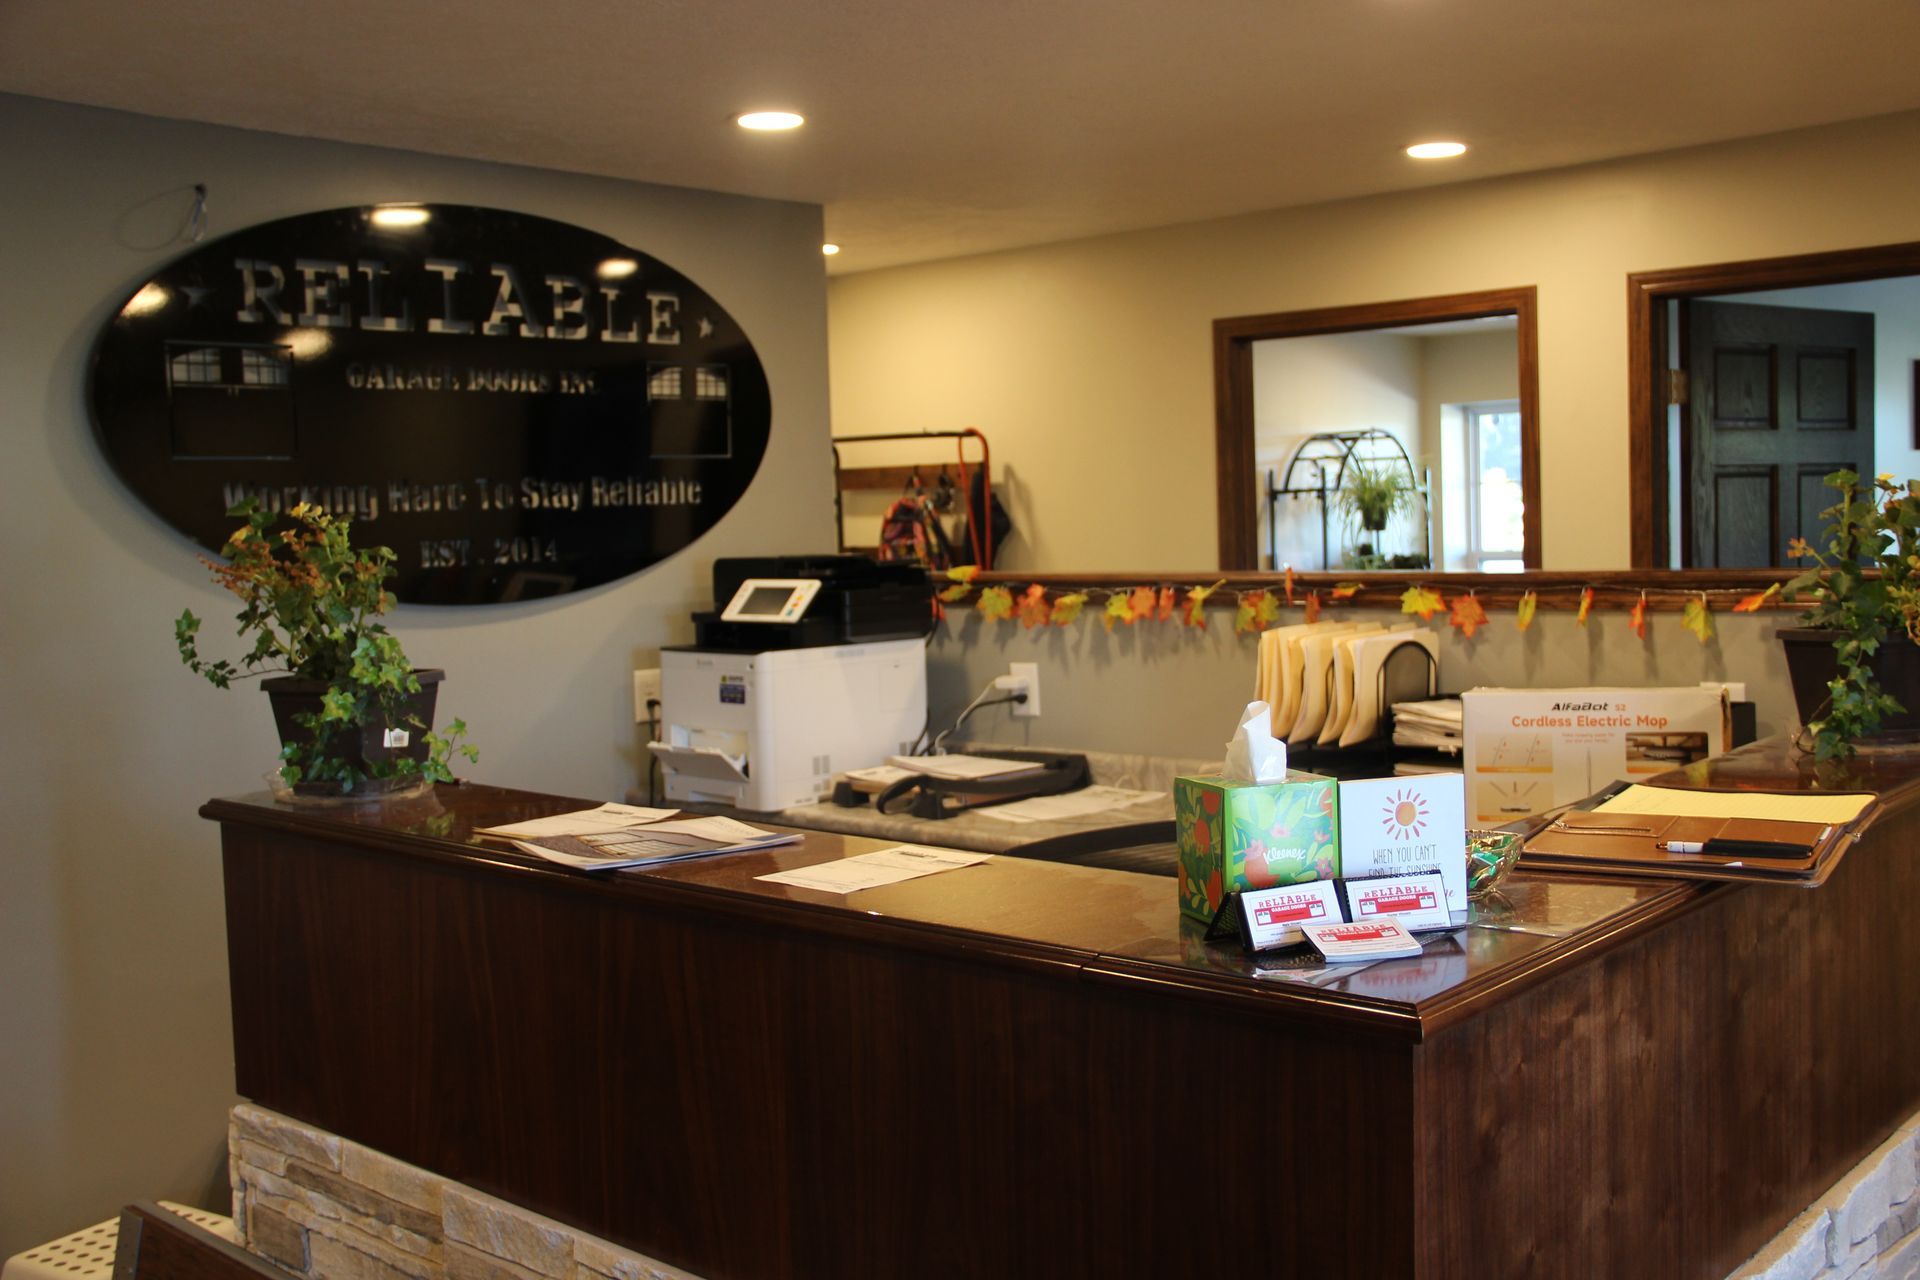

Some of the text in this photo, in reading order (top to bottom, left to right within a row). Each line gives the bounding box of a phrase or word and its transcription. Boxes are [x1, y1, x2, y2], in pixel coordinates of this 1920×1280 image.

[235, 258, 681, 346] RELIABLE
[222, 479, 379, 521] Working
[475, 478, 513, 511] To
[520, 476, 585, 512] Stay
[591, 475, 703, 507] Reliable
[494, 536, 558, 565] 2014
[1511, 714, 1668, 729] Cordless Electric Mop
[1263, 847, 1306, 865] Kleenex
[1372, 844, 1437, 865] WHEN YOU CAN'T
[1363, 885, 1428, 898] RELIABLE
[1258, 894, 1317, 909] RELIABLE
